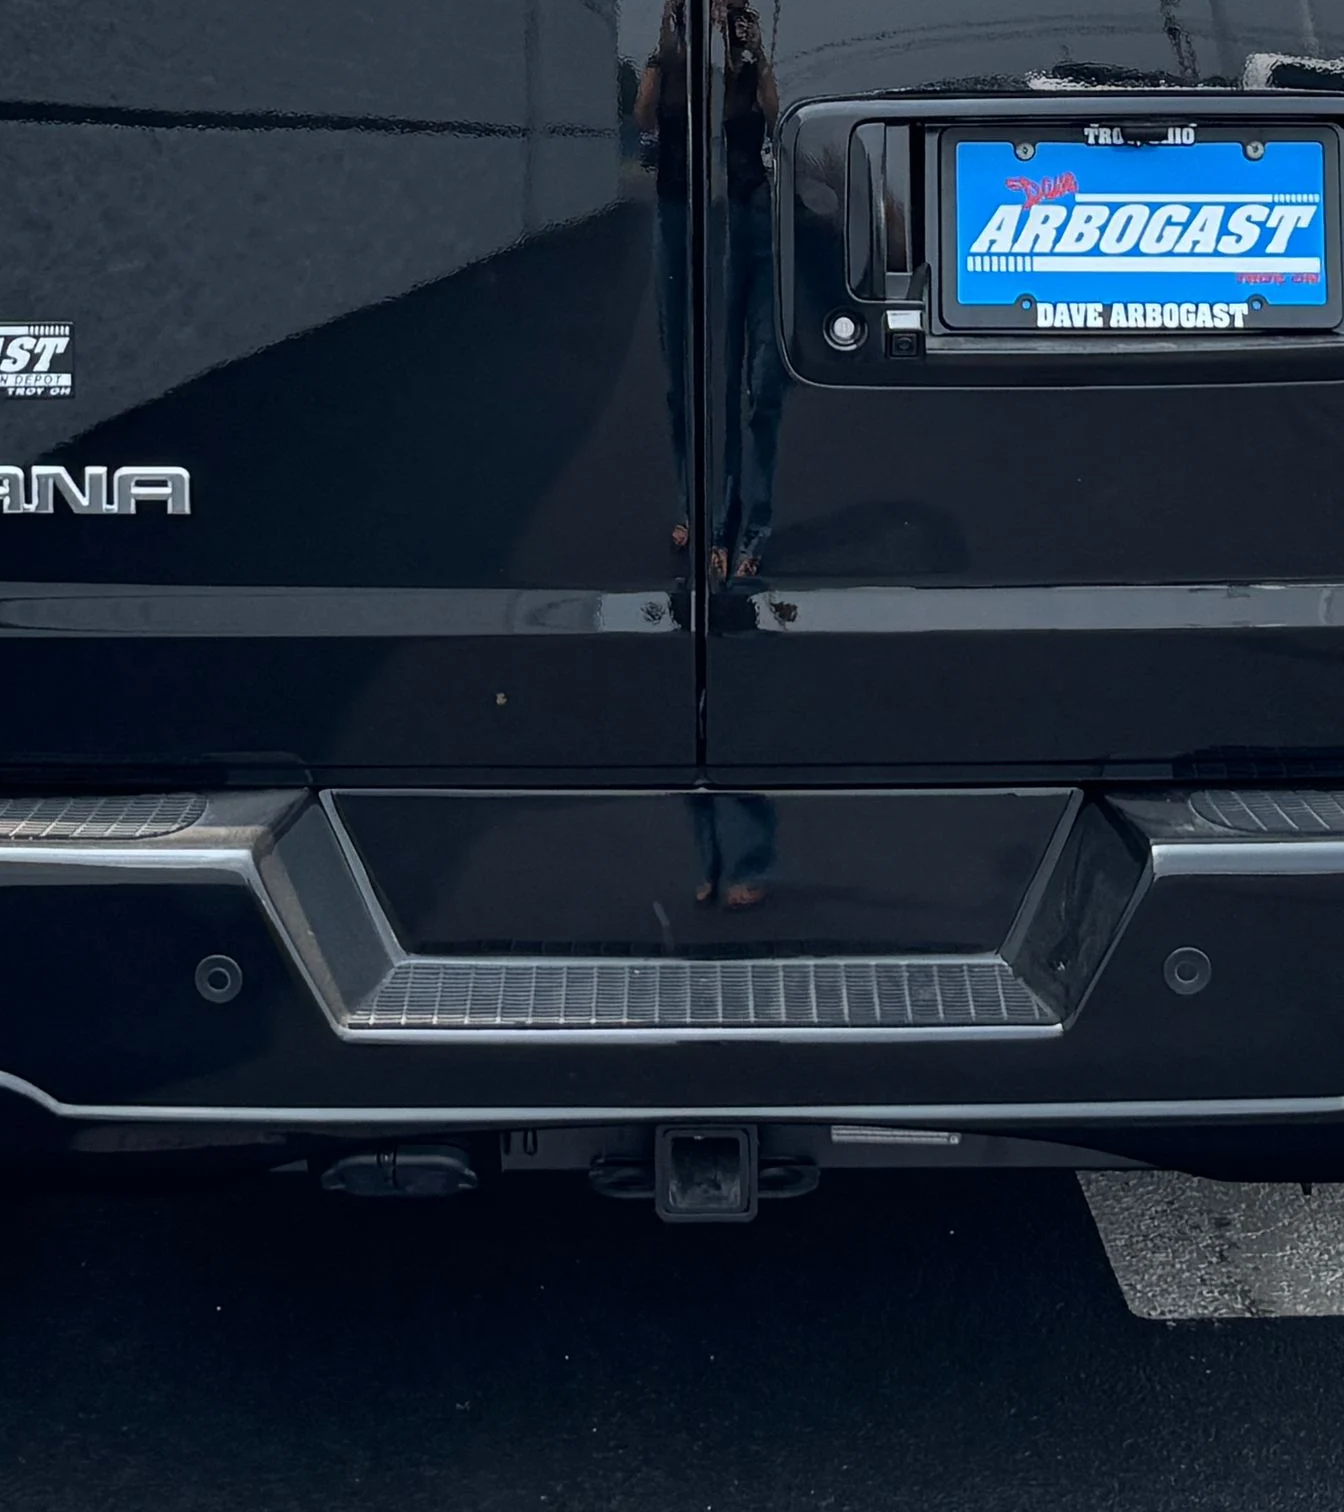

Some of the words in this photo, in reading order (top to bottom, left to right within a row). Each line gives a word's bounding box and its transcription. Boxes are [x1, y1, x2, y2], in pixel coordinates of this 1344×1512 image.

[969, 203, 1317, 254] ARBOGAST
[1037, 302, 1103, 328] DAVE
[1109, 302, 1248, 328] ARBOGAST
[14, 375, 63, 385] DEPOT
[7, 387, 44, 396] TROY
[50, 387, 71, 396] OH
